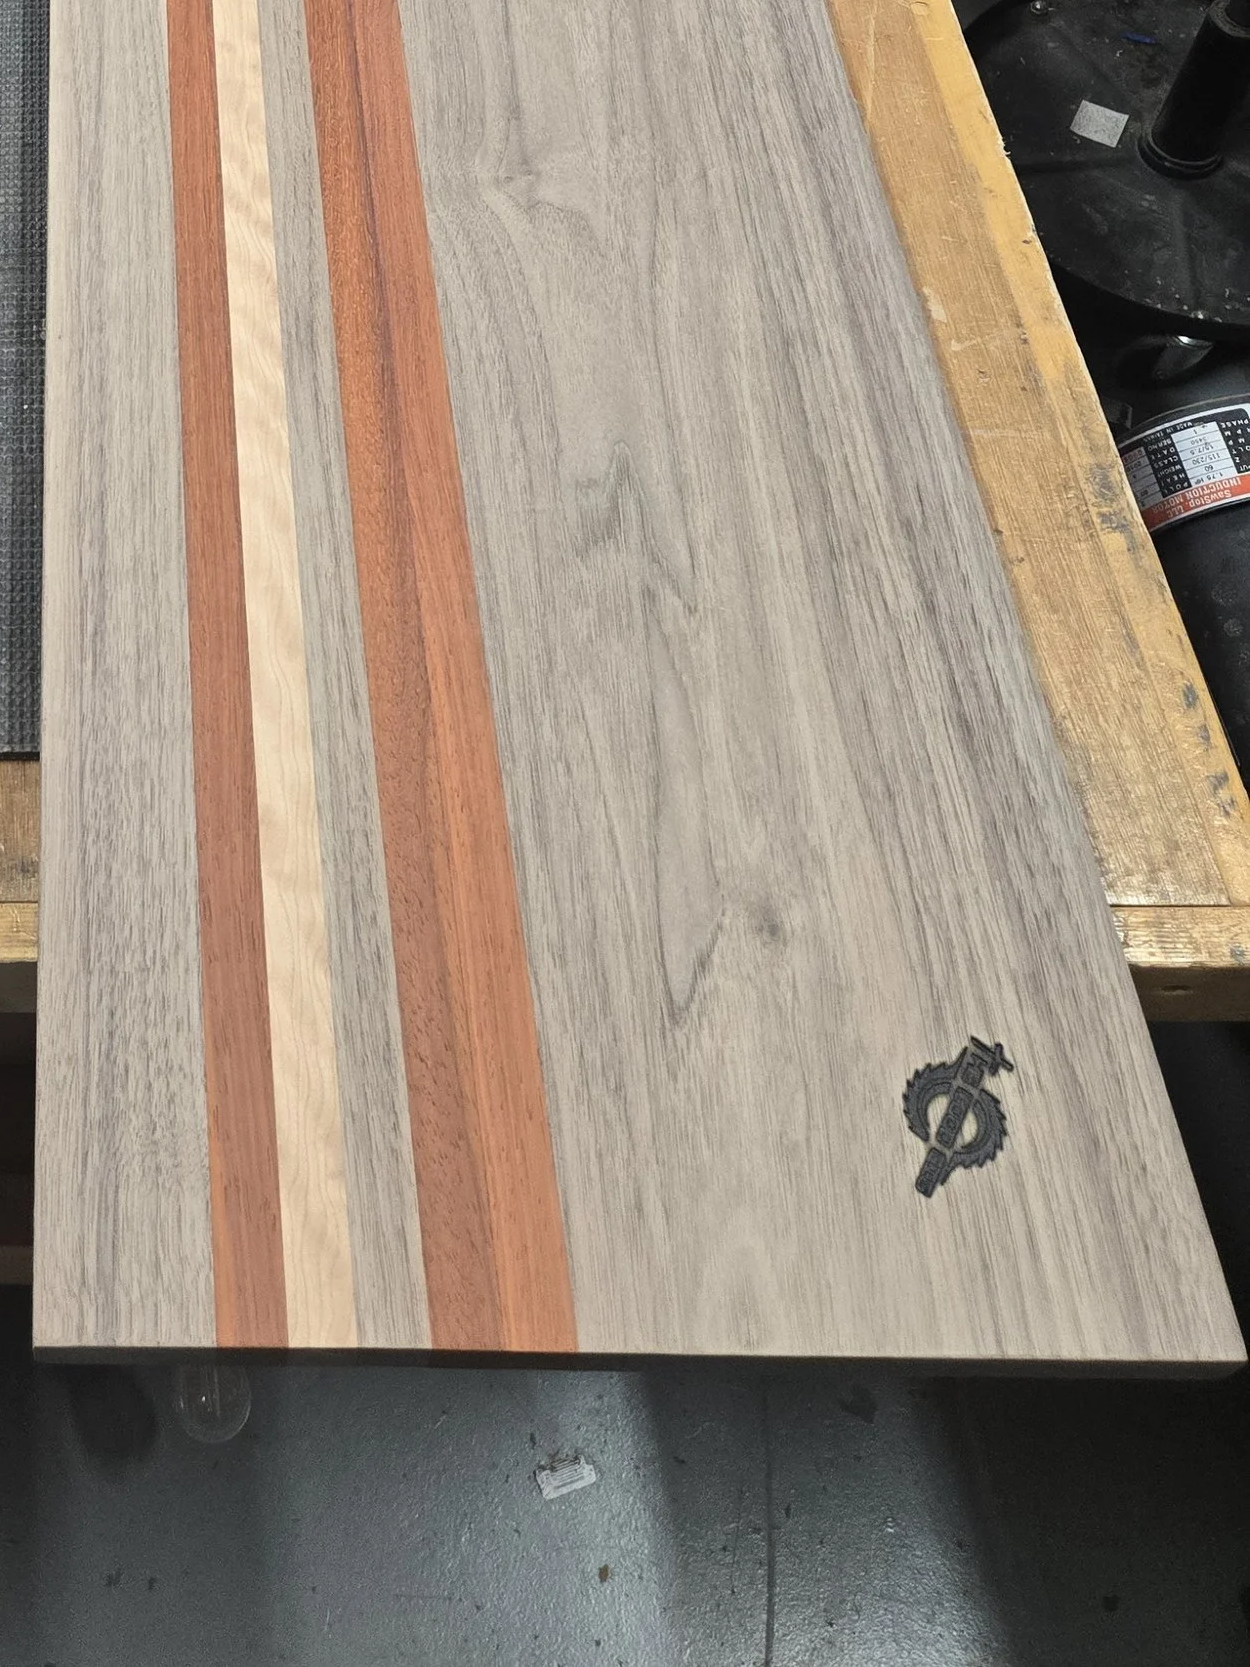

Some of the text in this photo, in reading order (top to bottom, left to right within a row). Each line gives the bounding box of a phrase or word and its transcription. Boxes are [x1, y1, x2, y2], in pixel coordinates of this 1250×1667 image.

[1176, 422, 1193, 431] MADE
[1220, 418, 1250, 429] PHASE
[1153, 455, 1179, 469] CLASS
[1191, 452, 1221, 466] 115/230
[1204, 464, 1214, 472] 60
[1151, 477, 1242, 514] INDUCTION MOTOR
[1166, 504, 1185, 519] LLC
